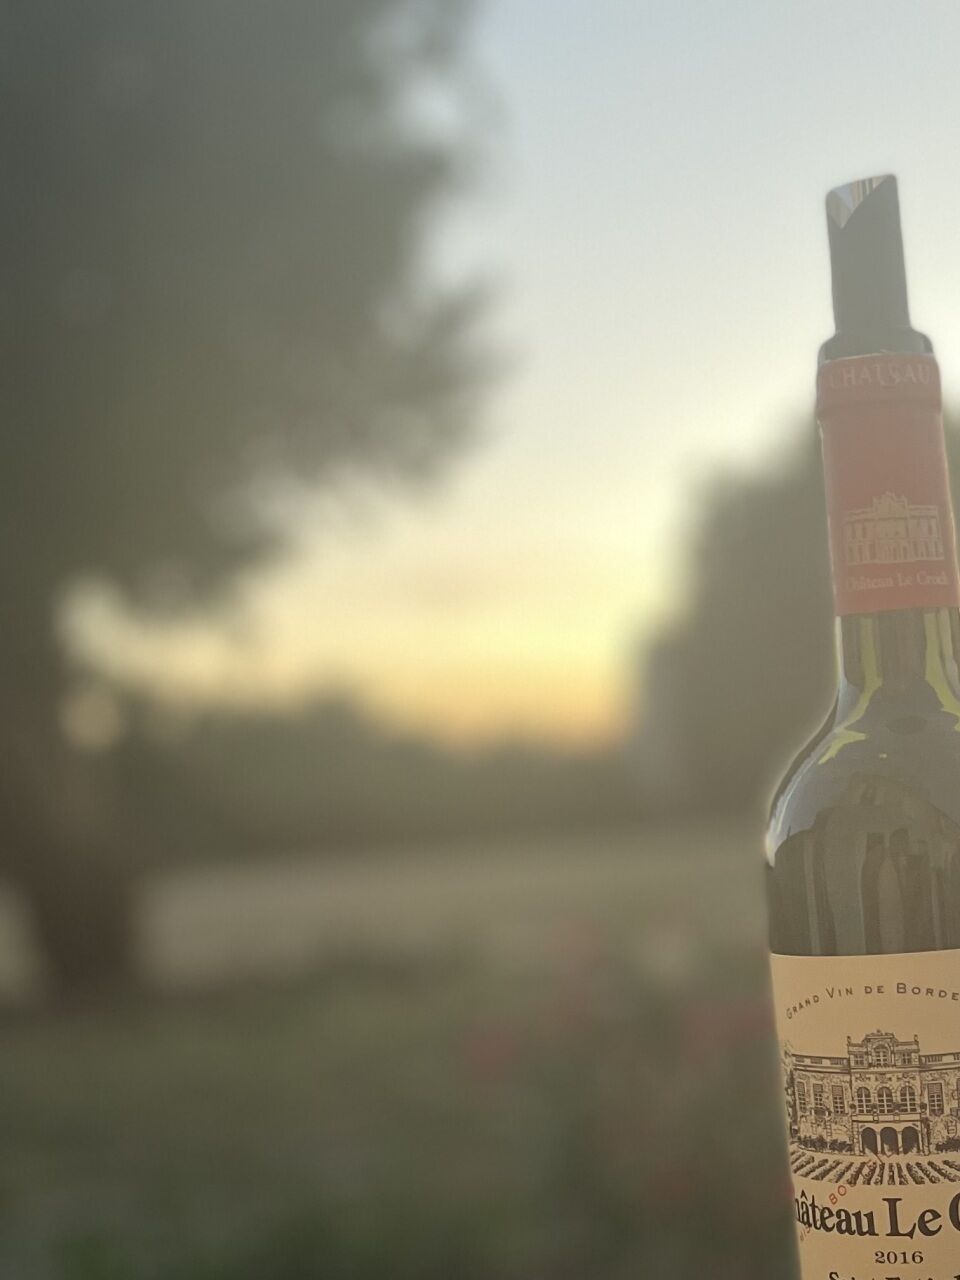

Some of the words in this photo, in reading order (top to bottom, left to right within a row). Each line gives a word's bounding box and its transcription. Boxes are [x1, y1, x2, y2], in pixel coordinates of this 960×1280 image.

[786, 994, 820, 1019] GRAND
[826, 987, 853, 999] VIN
[864, 985, 885, 994] DE
[795, 1189, 879, 1236] âteau
[882, 1197, 943, 1239] Le
[874, 1250, 924, 1265] 2016
